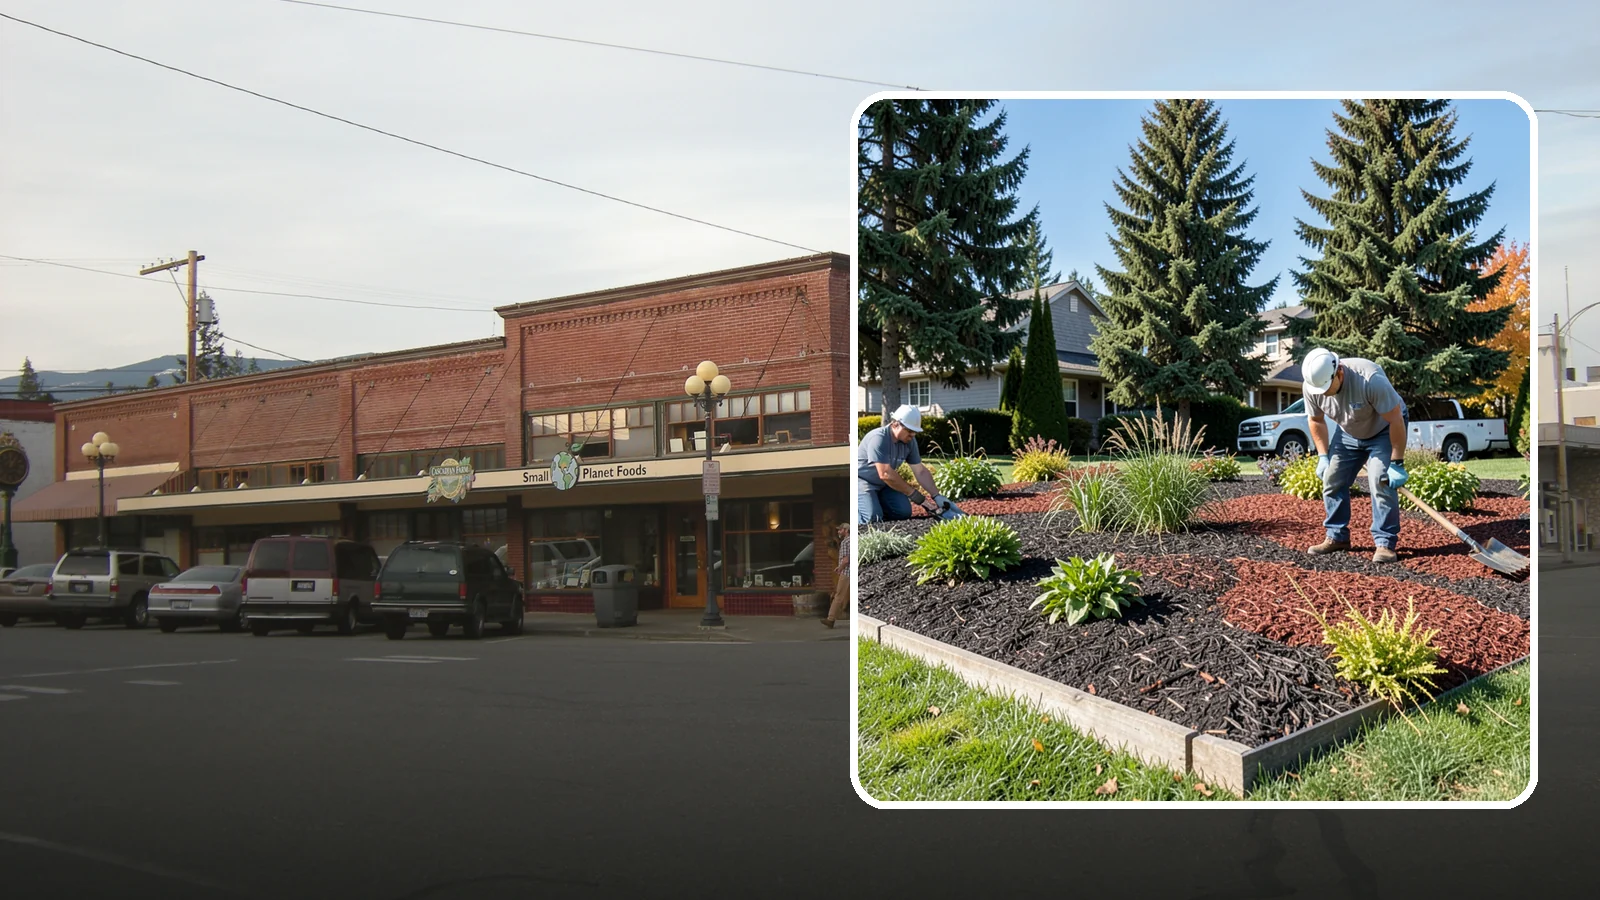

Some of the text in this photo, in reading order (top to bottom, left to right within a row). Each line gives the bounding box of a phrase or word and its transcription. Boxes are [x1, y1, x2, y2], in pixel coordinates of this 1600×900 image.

[523, 464, 647, 483] Small Planet Foods
